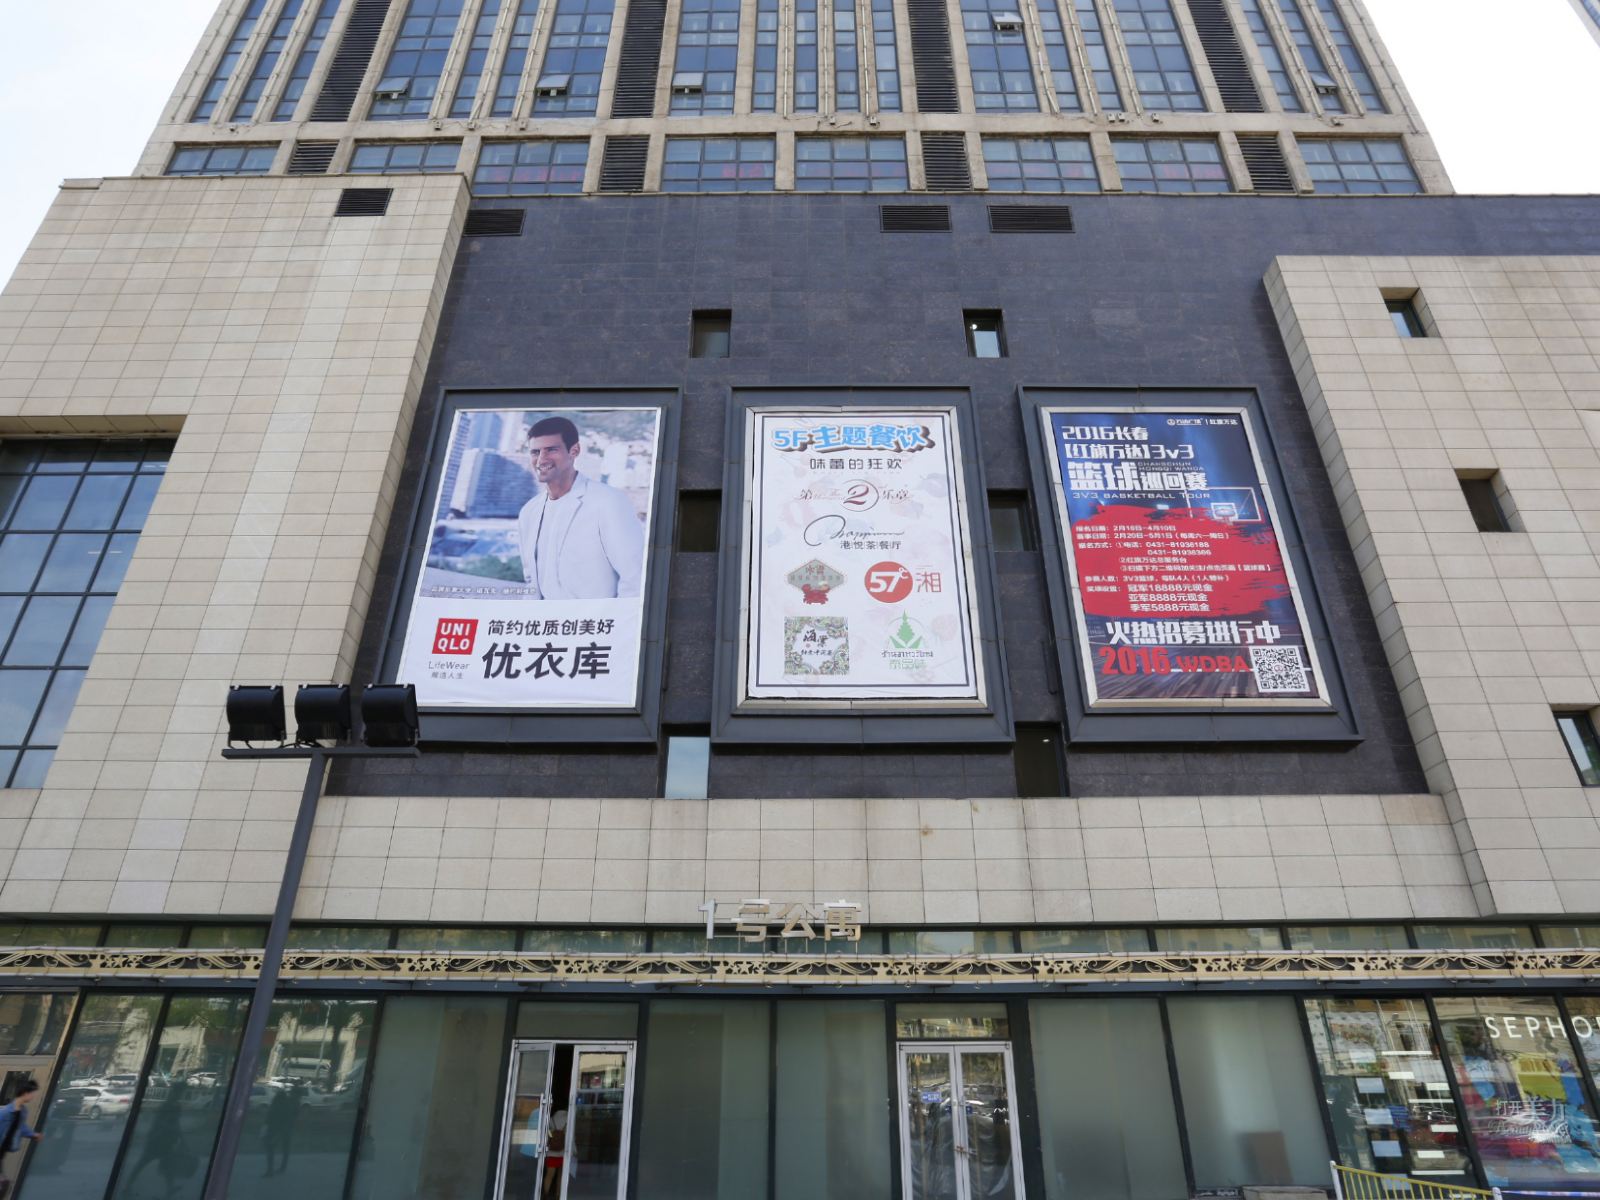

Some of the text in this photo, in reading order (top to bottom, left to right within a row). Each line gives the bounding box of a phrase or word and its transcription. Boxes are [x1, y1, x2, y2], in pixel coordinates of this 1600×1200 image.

[773, 424, 929, 450] 5F主题餐饮
[1061, 426, 1148, 440] 2016长春
[810, 458, 902, 470] 味蕾的狂欢
[1067, 461, 1209, 491] 篮球巡回赛
[915, 571, 942, 593] 湘
[1128, 593, 1208, 602] 亚军8888元现金
[1130, 603, 1210, 612] 季军5888元现金
[440, 622, 471, 636] UNI
[488, 619, 615, 636] 简约优质创美好
[1106, 620, 1281, 645] 火热招募进行中
[437, 638, 470, 652] QLO
[428, 661, 471, 670] LifeWear
[481, 641, 612, 680] 优衣库
[1098, 646, 1250, 675] 2016 WDBA
[698, 899, 862, 943] 1号公寓
[1484, 1015, 1600, 1039] SEPHO
